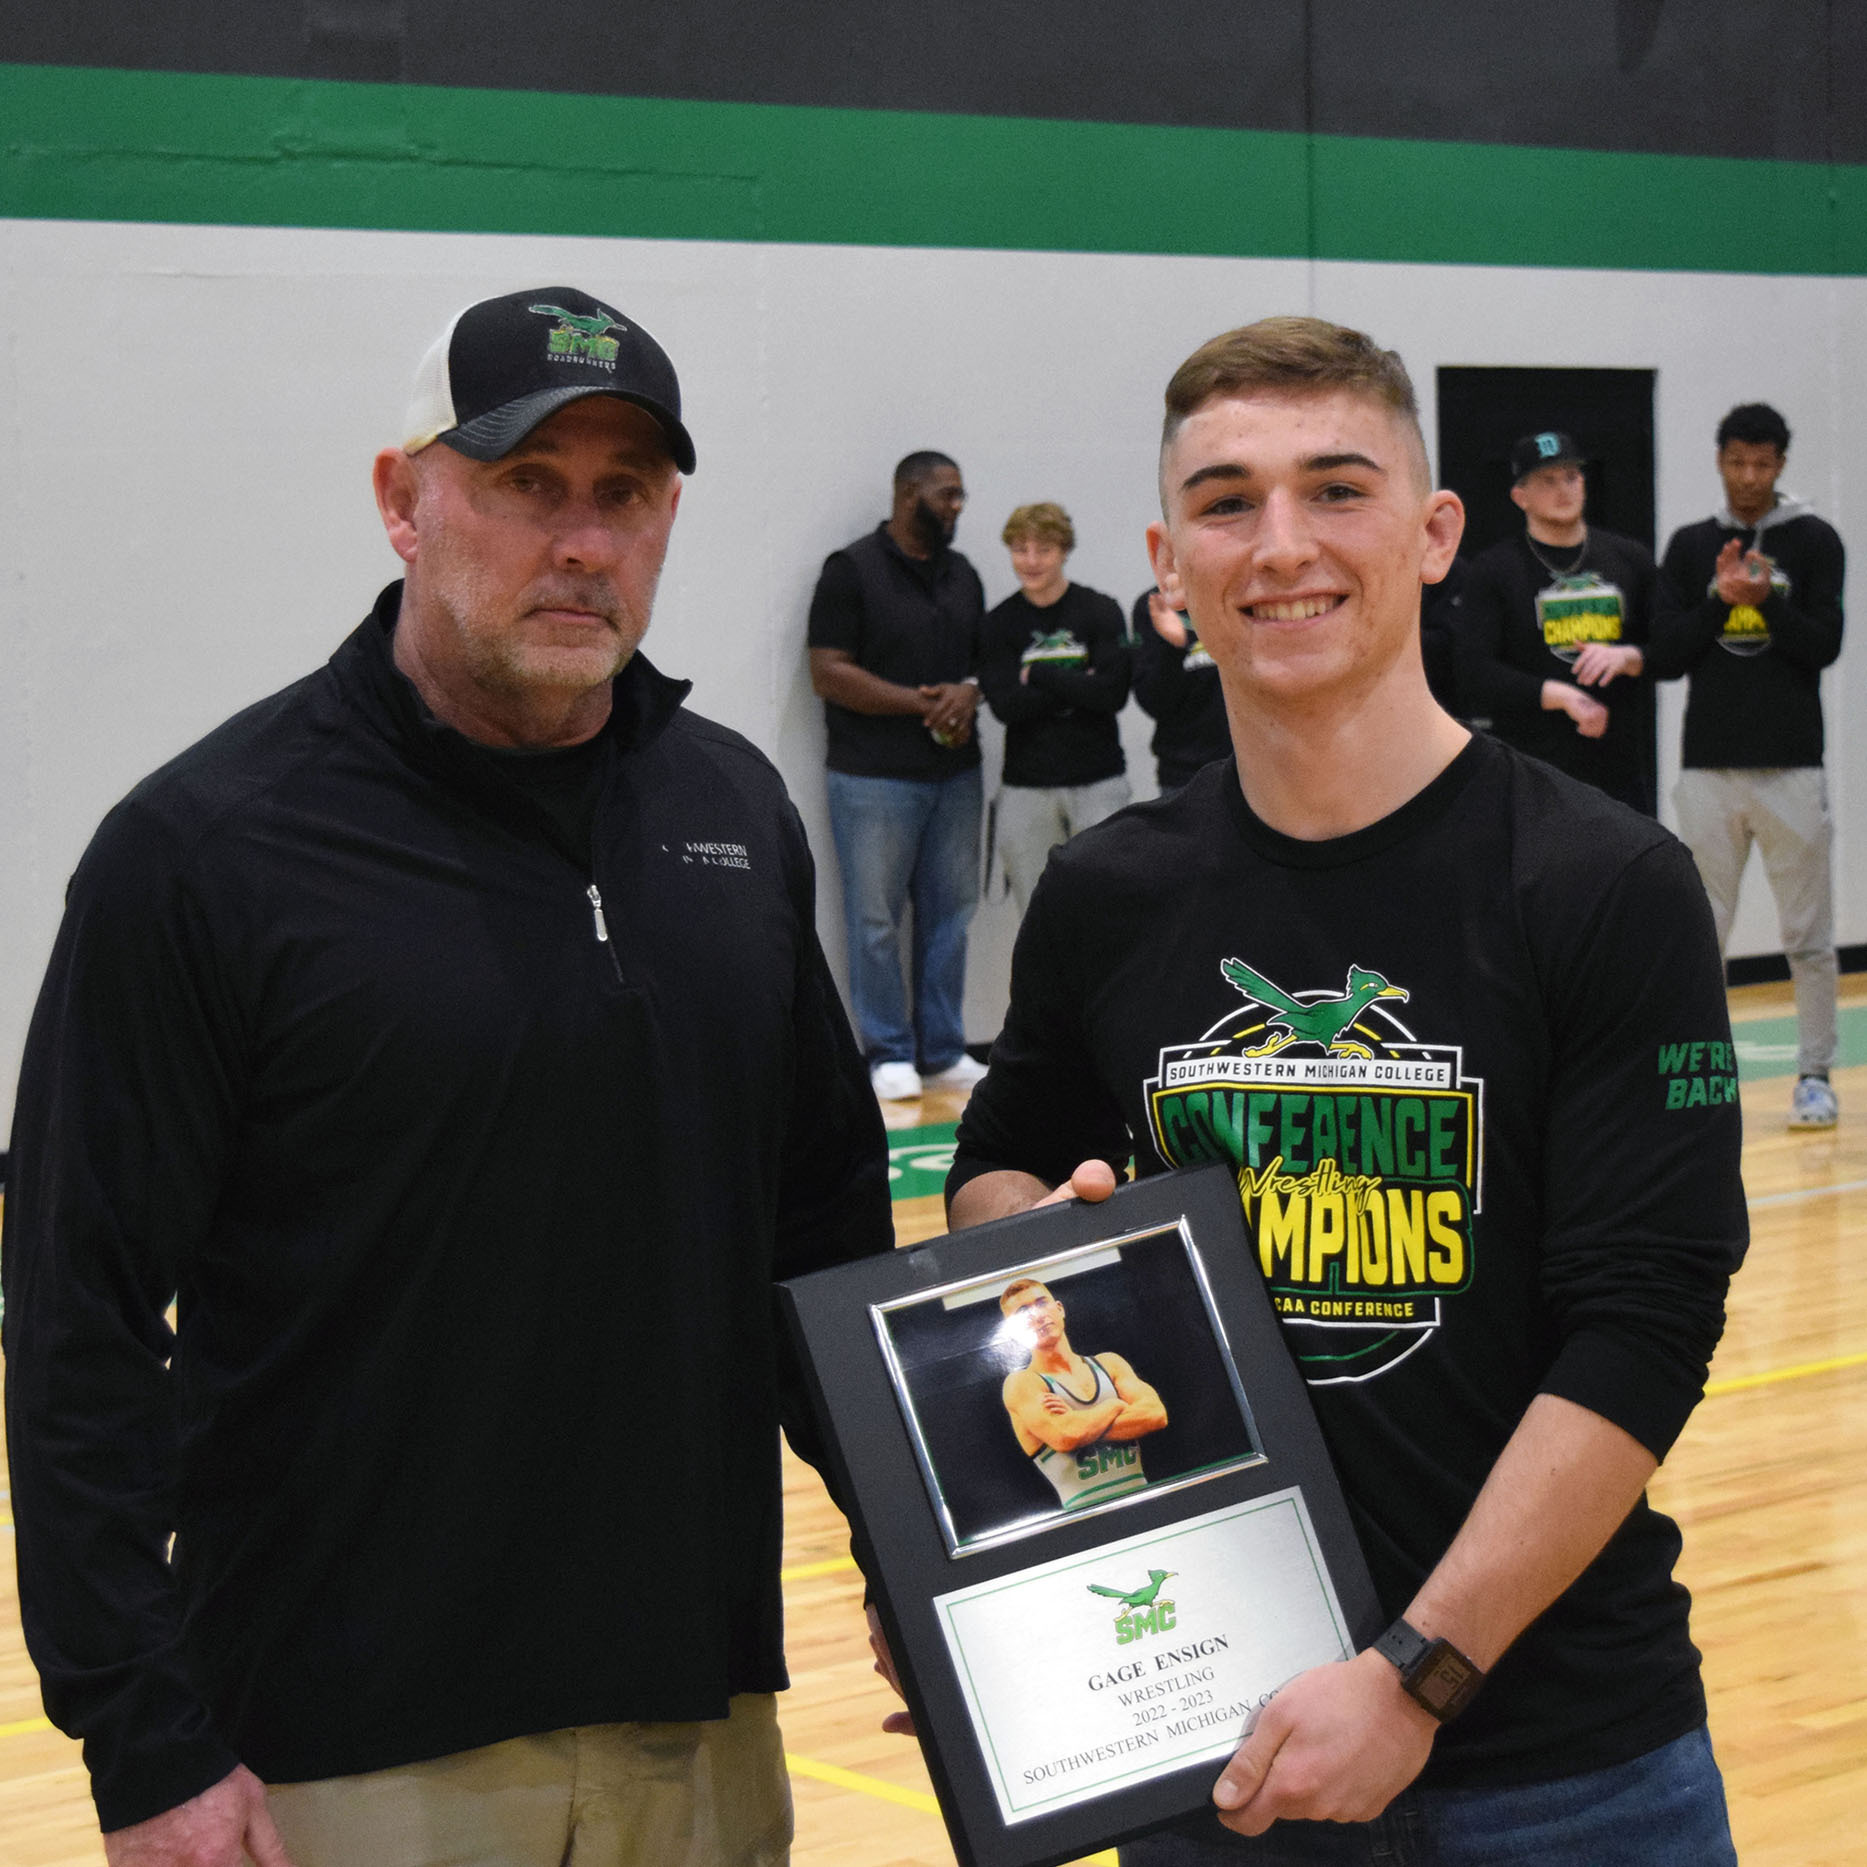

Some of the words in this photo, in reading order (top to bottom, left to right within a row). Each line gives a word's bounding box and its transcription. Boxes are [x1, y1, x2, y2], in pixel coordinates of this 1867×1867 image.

[1170, 1061, 1296, 1080] SOUTHWESTERN
[1304, 1064, 1368, 1079] MICHIGAN
[1374, 1065, 1445, 1082] COLLEGE
[1665, 1075, 1737, 1110] BACK
[1162, 1090, 1460, 1177] CONFERENCE
[1310, 1300, 1415, 1317] CONFERENCE
[1115, 1600, 1177, 1646] SMC
[1088, 1660, 1146, 1692] GAGE
[1153, 1633, 1230, 1682] ENSIGN
[1117, 1665, 1215, 1708] WRESTLING
[1132, 1704, 1168, 1727] 2022
[1179, 1689, 1214, 1712] 2023
[1022, 1728, 1160, 1785] SOUTHWESTERN
[1165, 1699, 1252, 1740] MICHIGAN
